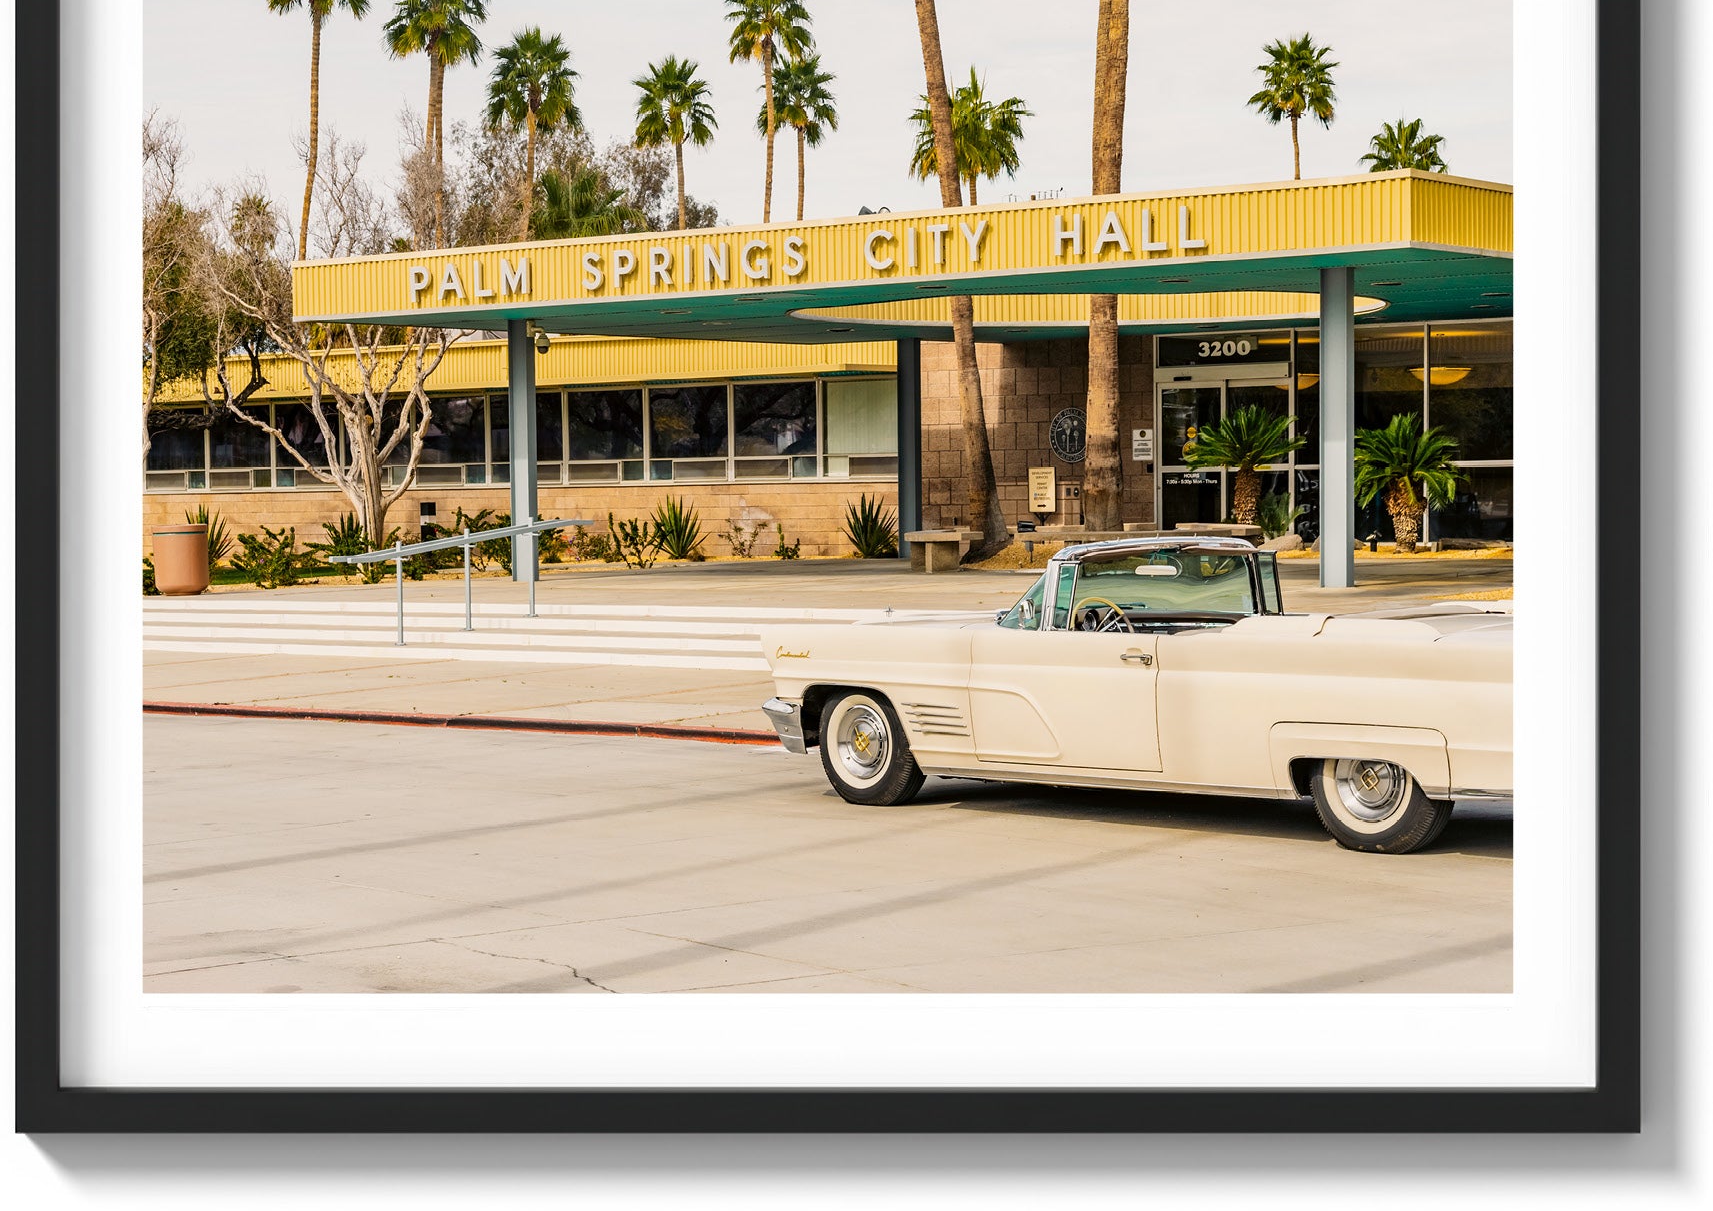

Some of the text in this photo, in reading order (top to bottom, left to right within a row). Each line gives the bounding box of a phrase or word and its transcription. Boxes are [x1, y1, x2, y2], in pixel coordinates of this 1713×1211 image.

[409, 205, 1208, 303] PALM SPRINGS CITY HALL
[1198, 340, 1251, 357] 3200
